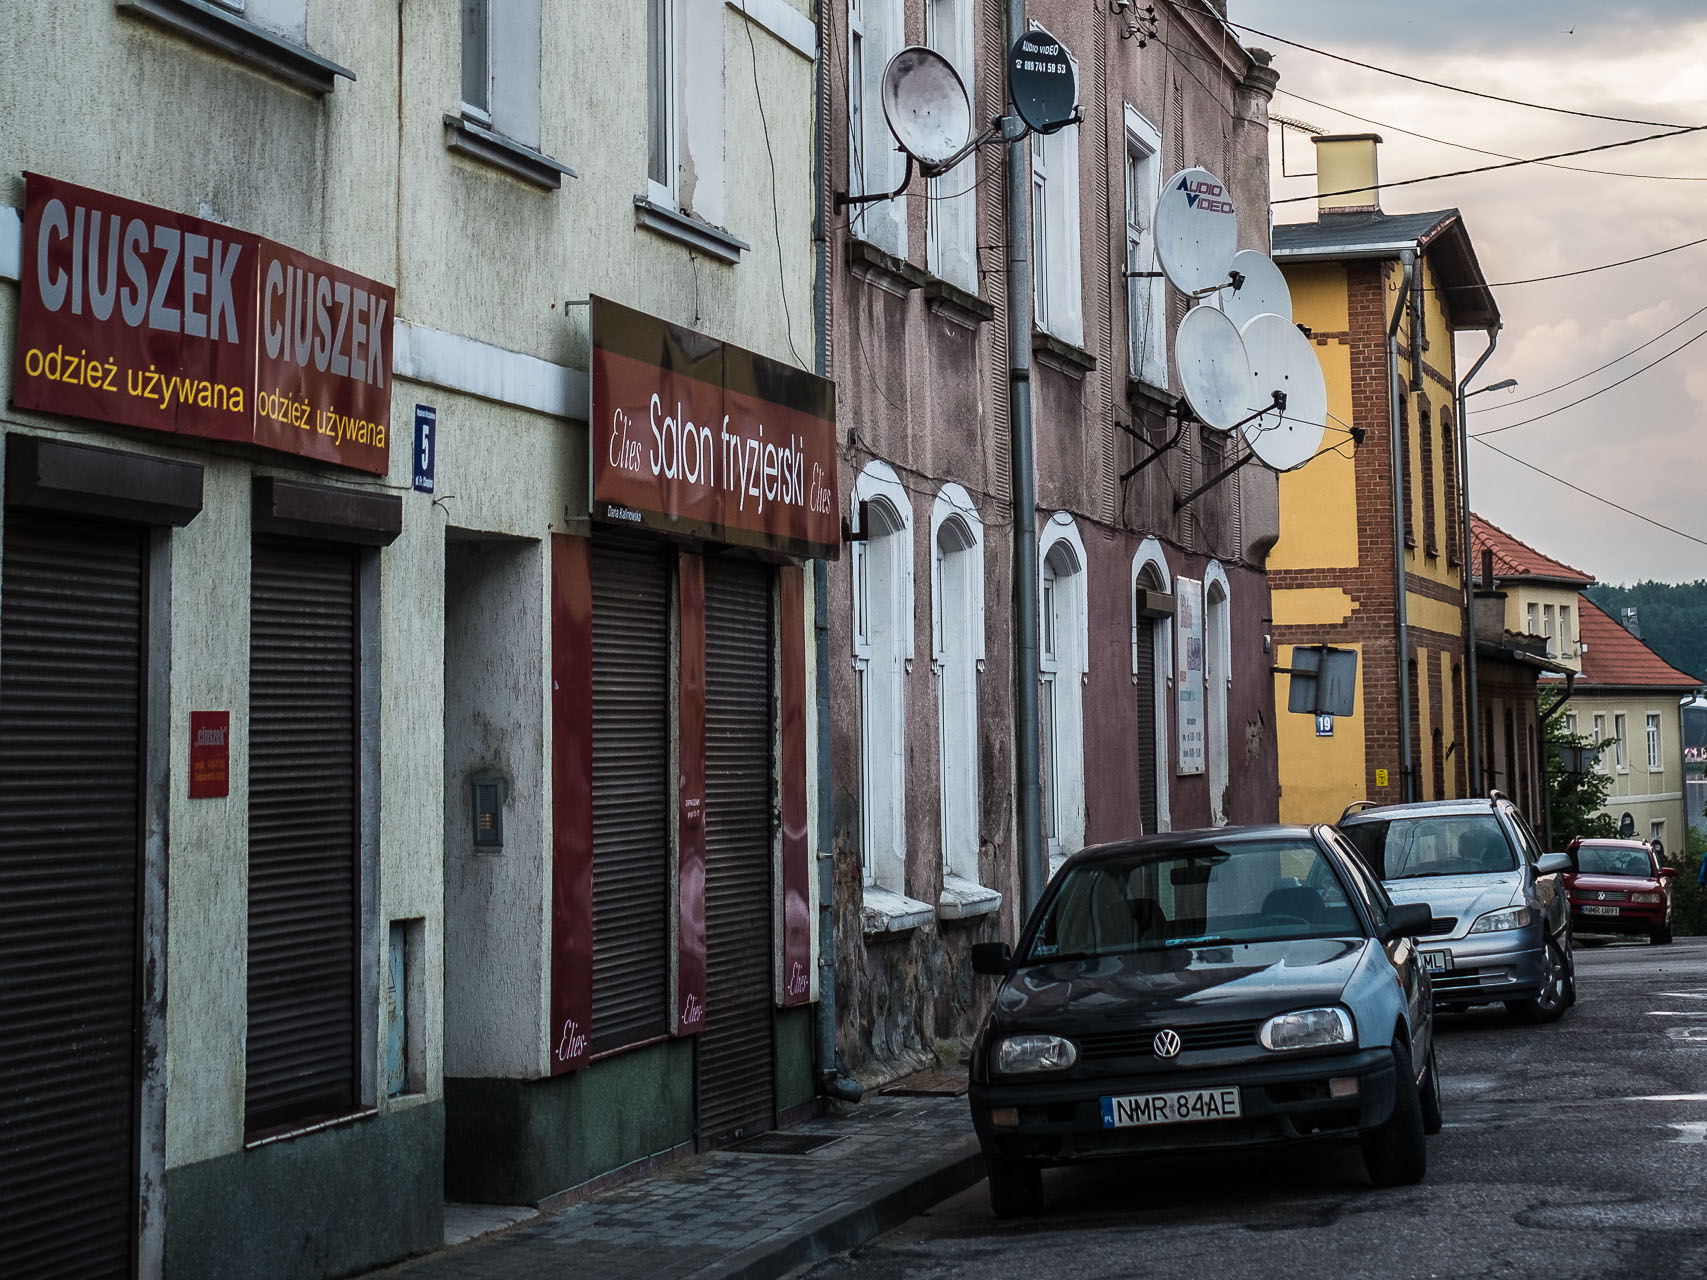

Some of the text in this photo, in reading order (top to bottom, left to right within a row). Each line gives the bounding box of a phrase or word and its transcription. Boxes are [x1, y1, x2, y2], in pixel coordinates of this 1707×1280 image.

[1022, 40, 1059, 56] AUDIO VIDEO
[1035, 61, 1046, 72] 741
[1047, 63, 1056, 73] 59
[1057, 64, 1066, 74] 53
[1176, 176, 1223, 197] AUDIO
[1185, 192, 1233, 214] VIDEO
[38, 199, 243, 344] CIUSZEK
[264, 259, 388, 388] CIUSZEK
[25, 344, 244, 413] odzież używana
[258, 388, 385, 449] odzież używana
[421, 424, 430, 471] 5
[609, 407, 642, 472] Elies
[650, 393, 714, 487] Salon
[721, 414, 804, 515] fryzjerski
[1319, 715, 1331, 731] 19
[1116, 1096, 1169, 1123] NMR
[1176, 1091, 1237, 1119] 84AE
